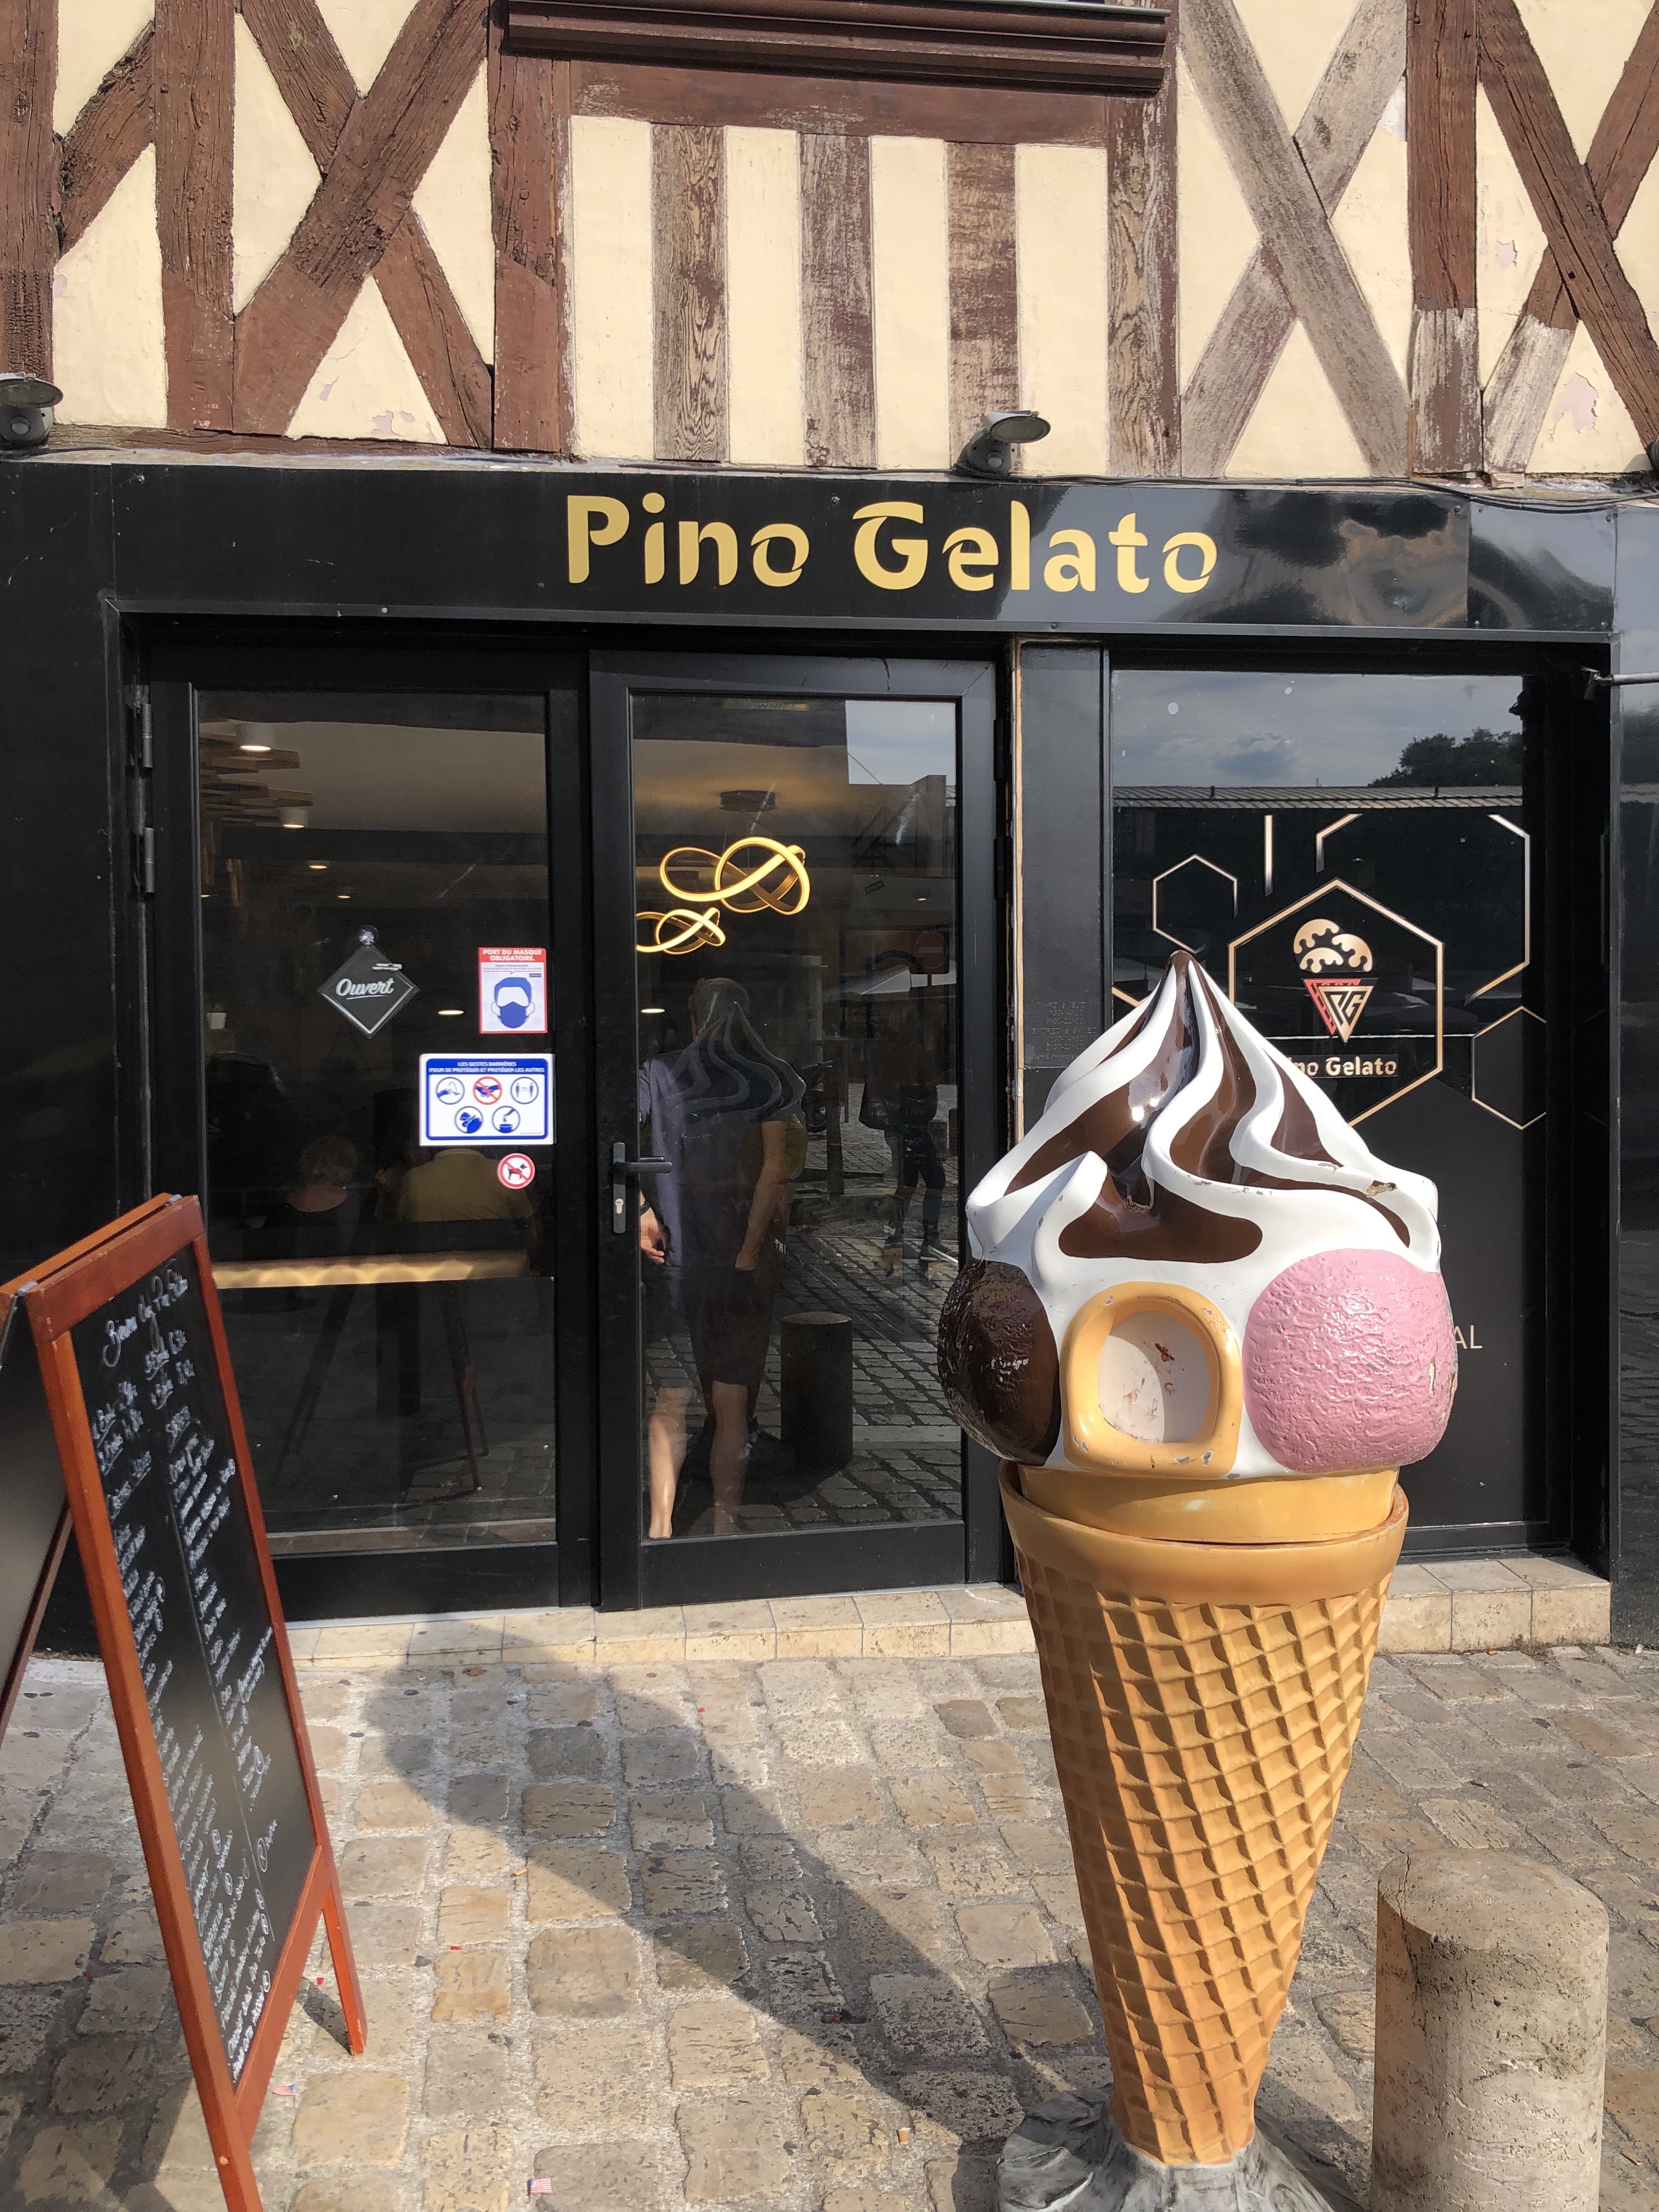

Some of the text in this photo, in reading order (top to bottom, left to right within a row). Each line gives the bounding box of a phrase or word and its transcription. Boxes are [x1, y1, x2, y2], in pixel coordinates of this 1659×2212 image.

[567, 492, 1218, 594] Pino Gelato
[335, 978, 395, 996] Ouvert
[1325, 1056, 1397, 1076] Gelato
